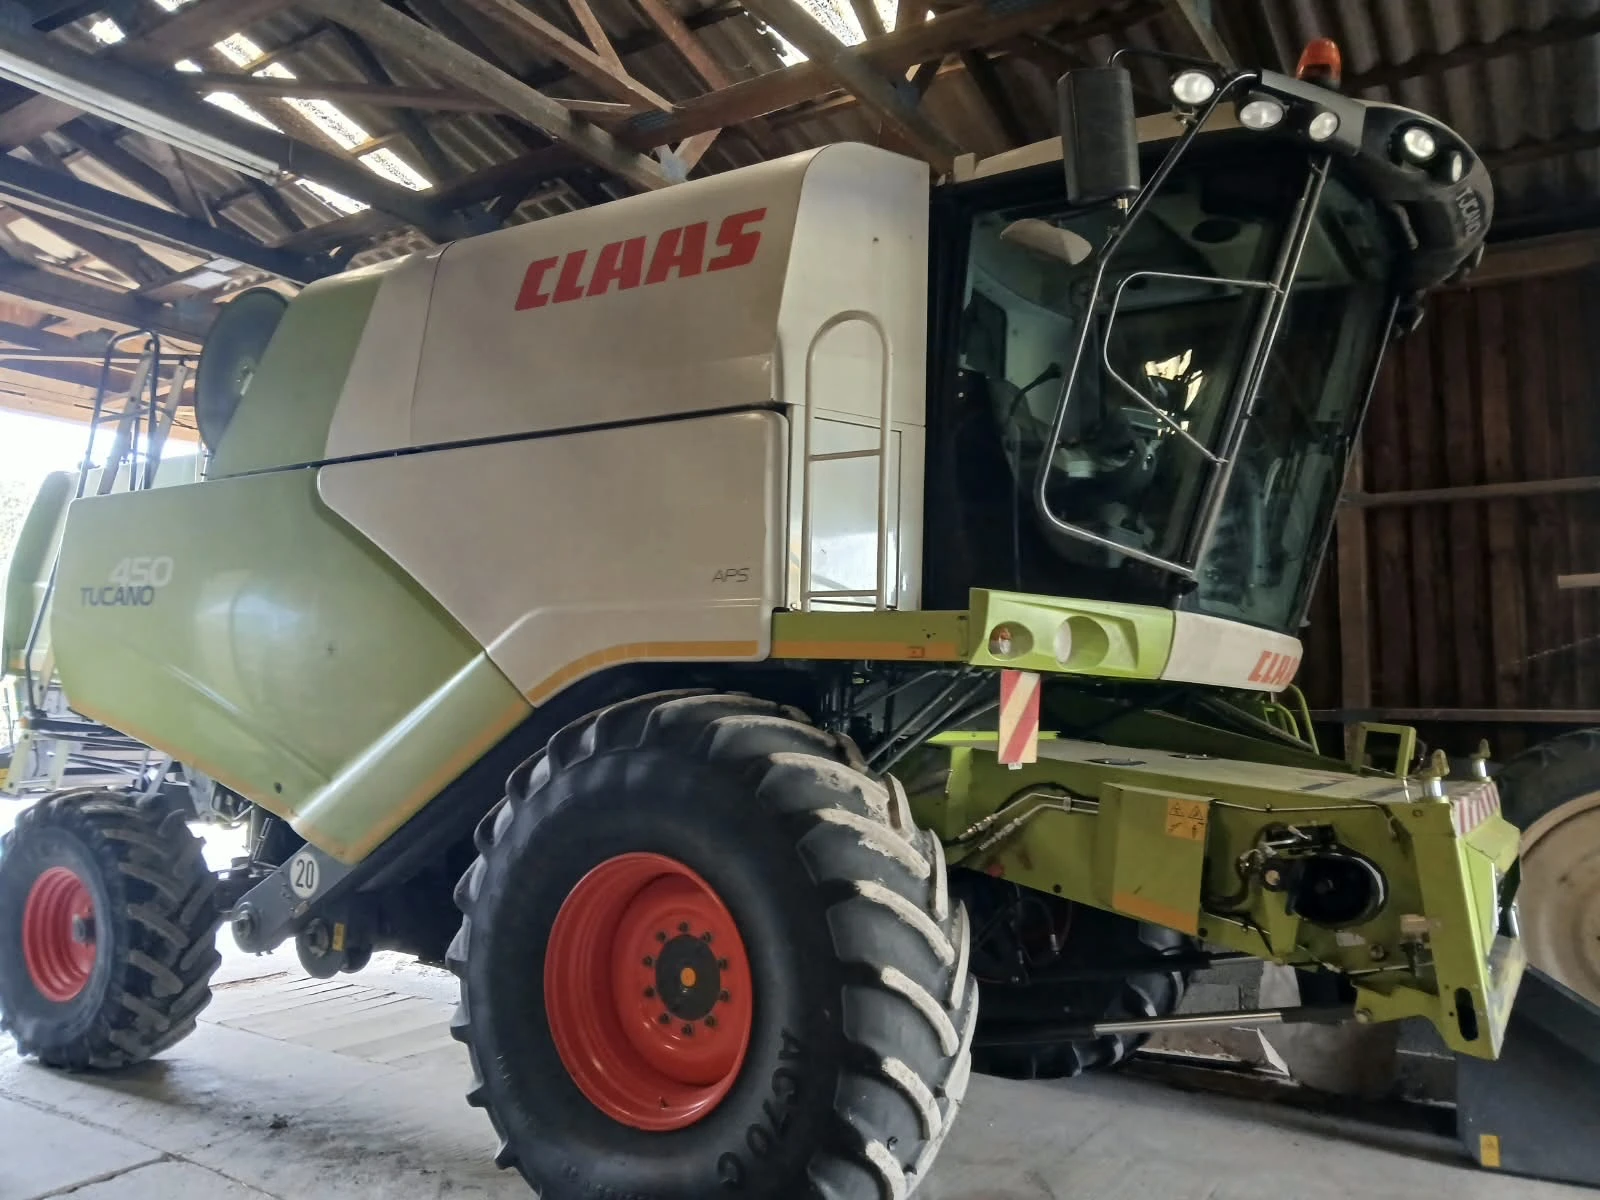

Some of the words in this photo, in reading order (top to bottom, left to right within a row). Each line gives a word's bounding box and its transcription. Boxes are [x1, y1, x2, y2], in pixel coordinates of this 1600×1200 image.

[514, 207, 768, 312] CLAAS
[108, 556, 174, 588] 450
[711, 567, 751, 583] APS
[80, 584, 155, 606] TUCANO
[295, 858, 315, 889] 20
